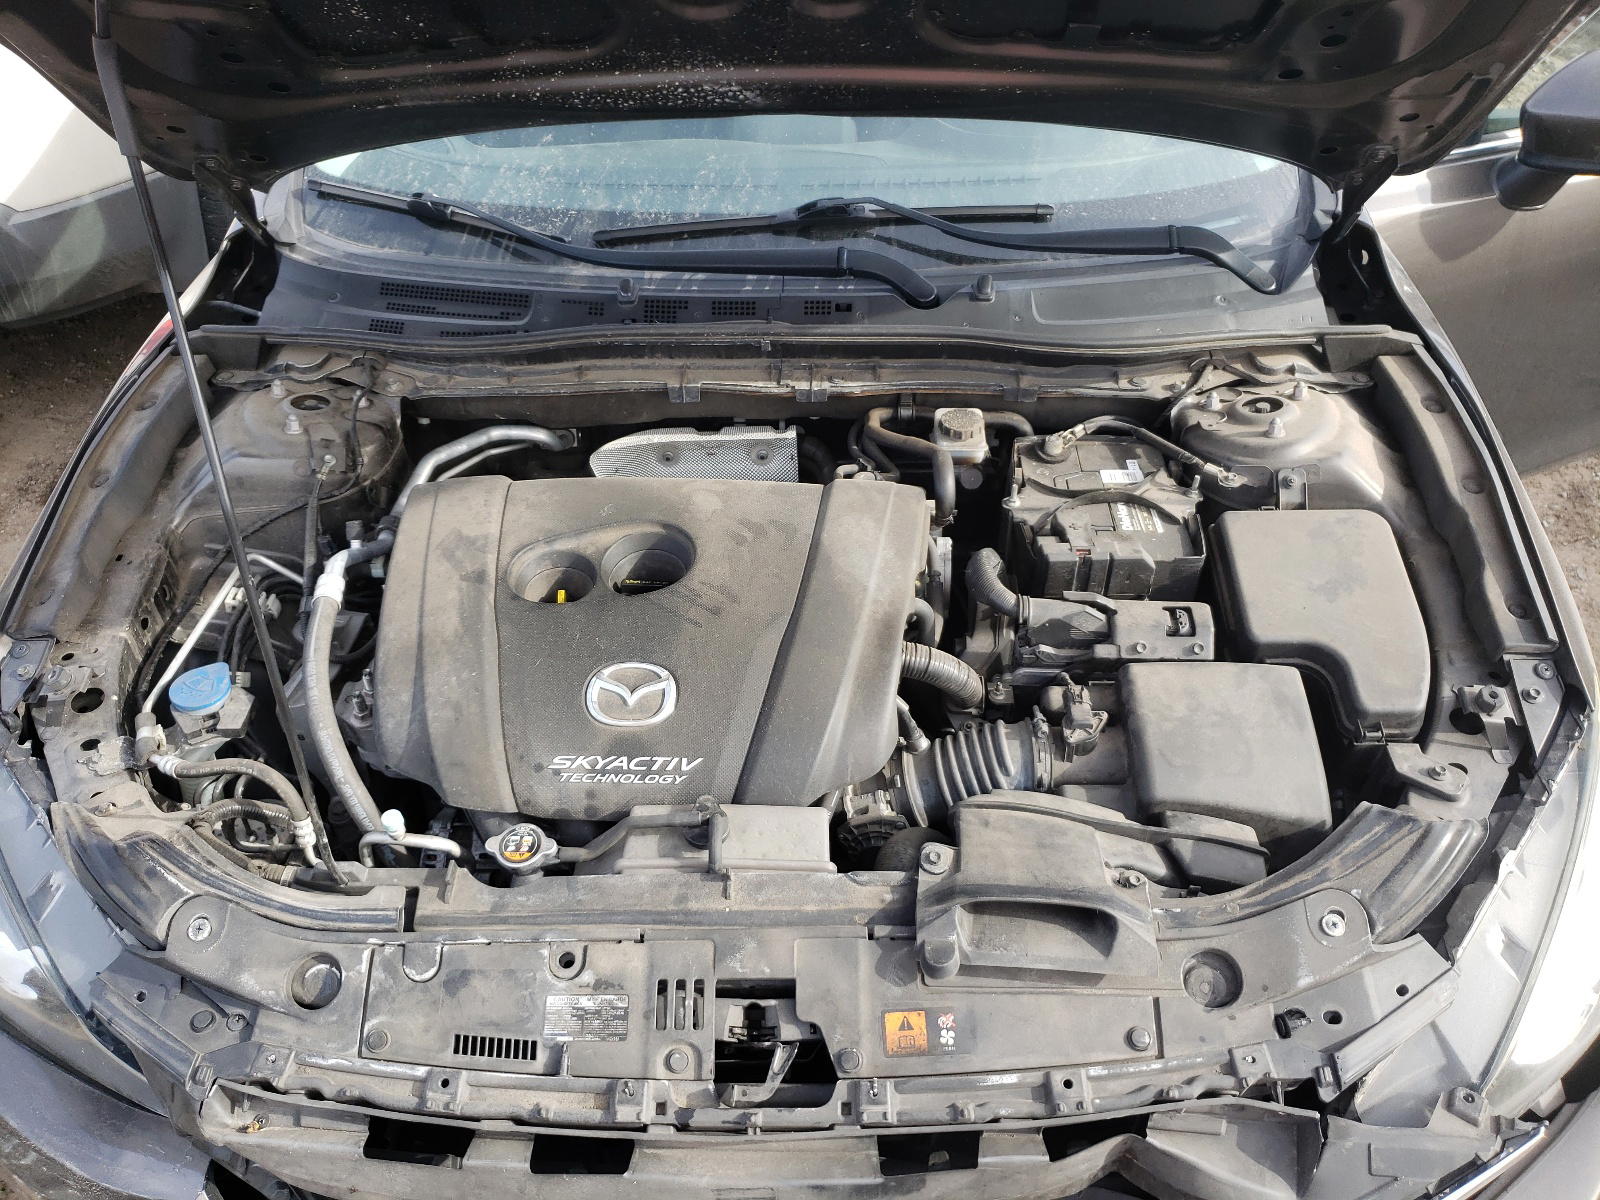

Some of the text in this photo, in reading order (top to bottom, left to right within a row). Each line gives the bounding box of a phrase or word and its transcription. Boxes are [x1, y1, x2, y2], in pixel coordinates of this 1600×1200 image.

[1116, 502, 1134, 531] DieHar
[547, 755, 704, 771] SKYACTIV
[559, 772, 688, 785] TECHNOLOGY
